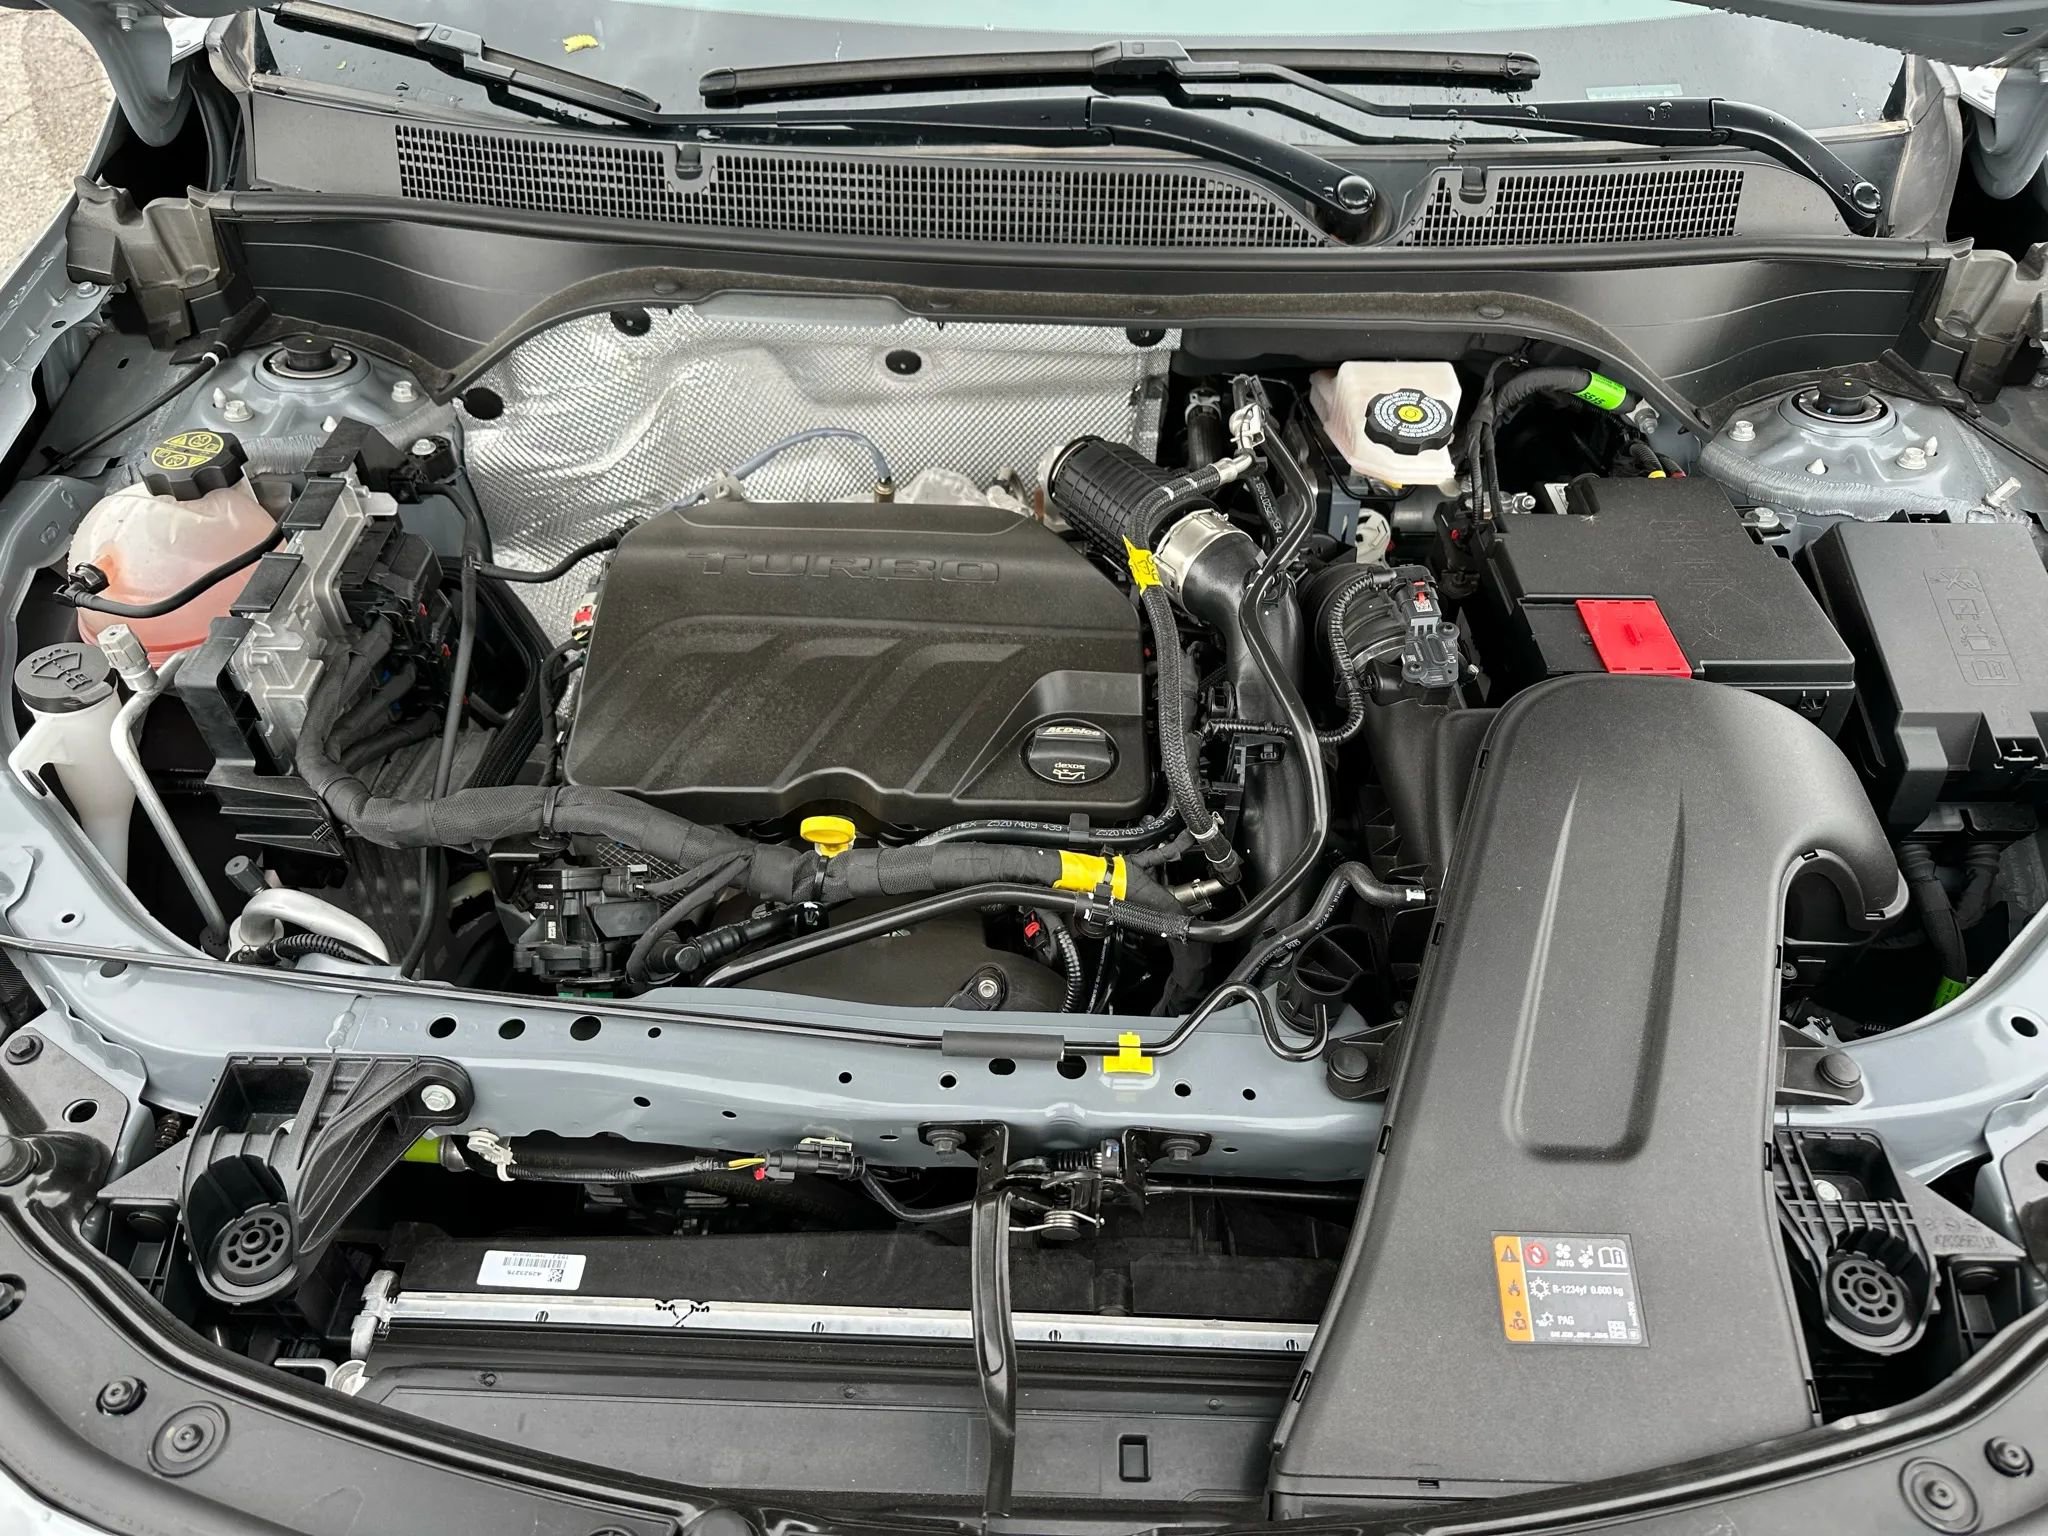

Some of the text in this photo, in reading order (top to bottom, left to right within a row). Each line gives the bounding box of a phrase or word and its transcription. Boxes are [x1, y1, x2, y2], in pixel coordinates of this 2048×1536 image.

[687, 553, 1000, 584] TURBO
[1044, 726, 1101, 736] ACDelco
[1054, 762, 1086, 770] dexos
[956, 820, 977, 830] MEX
[986, 819, 1039, 830] 25207409
[1042, 823, 1063, 832] 439
[1095, 827, 1145, 837] 25207409
[1555, 1259, 1575, 1268] AUTO
[1552, 1284, 1588, 1297] R-1234yf
[1613, 1285, 1624, 1297] kg
[1557, 1315, 1575, 1326] PAG
